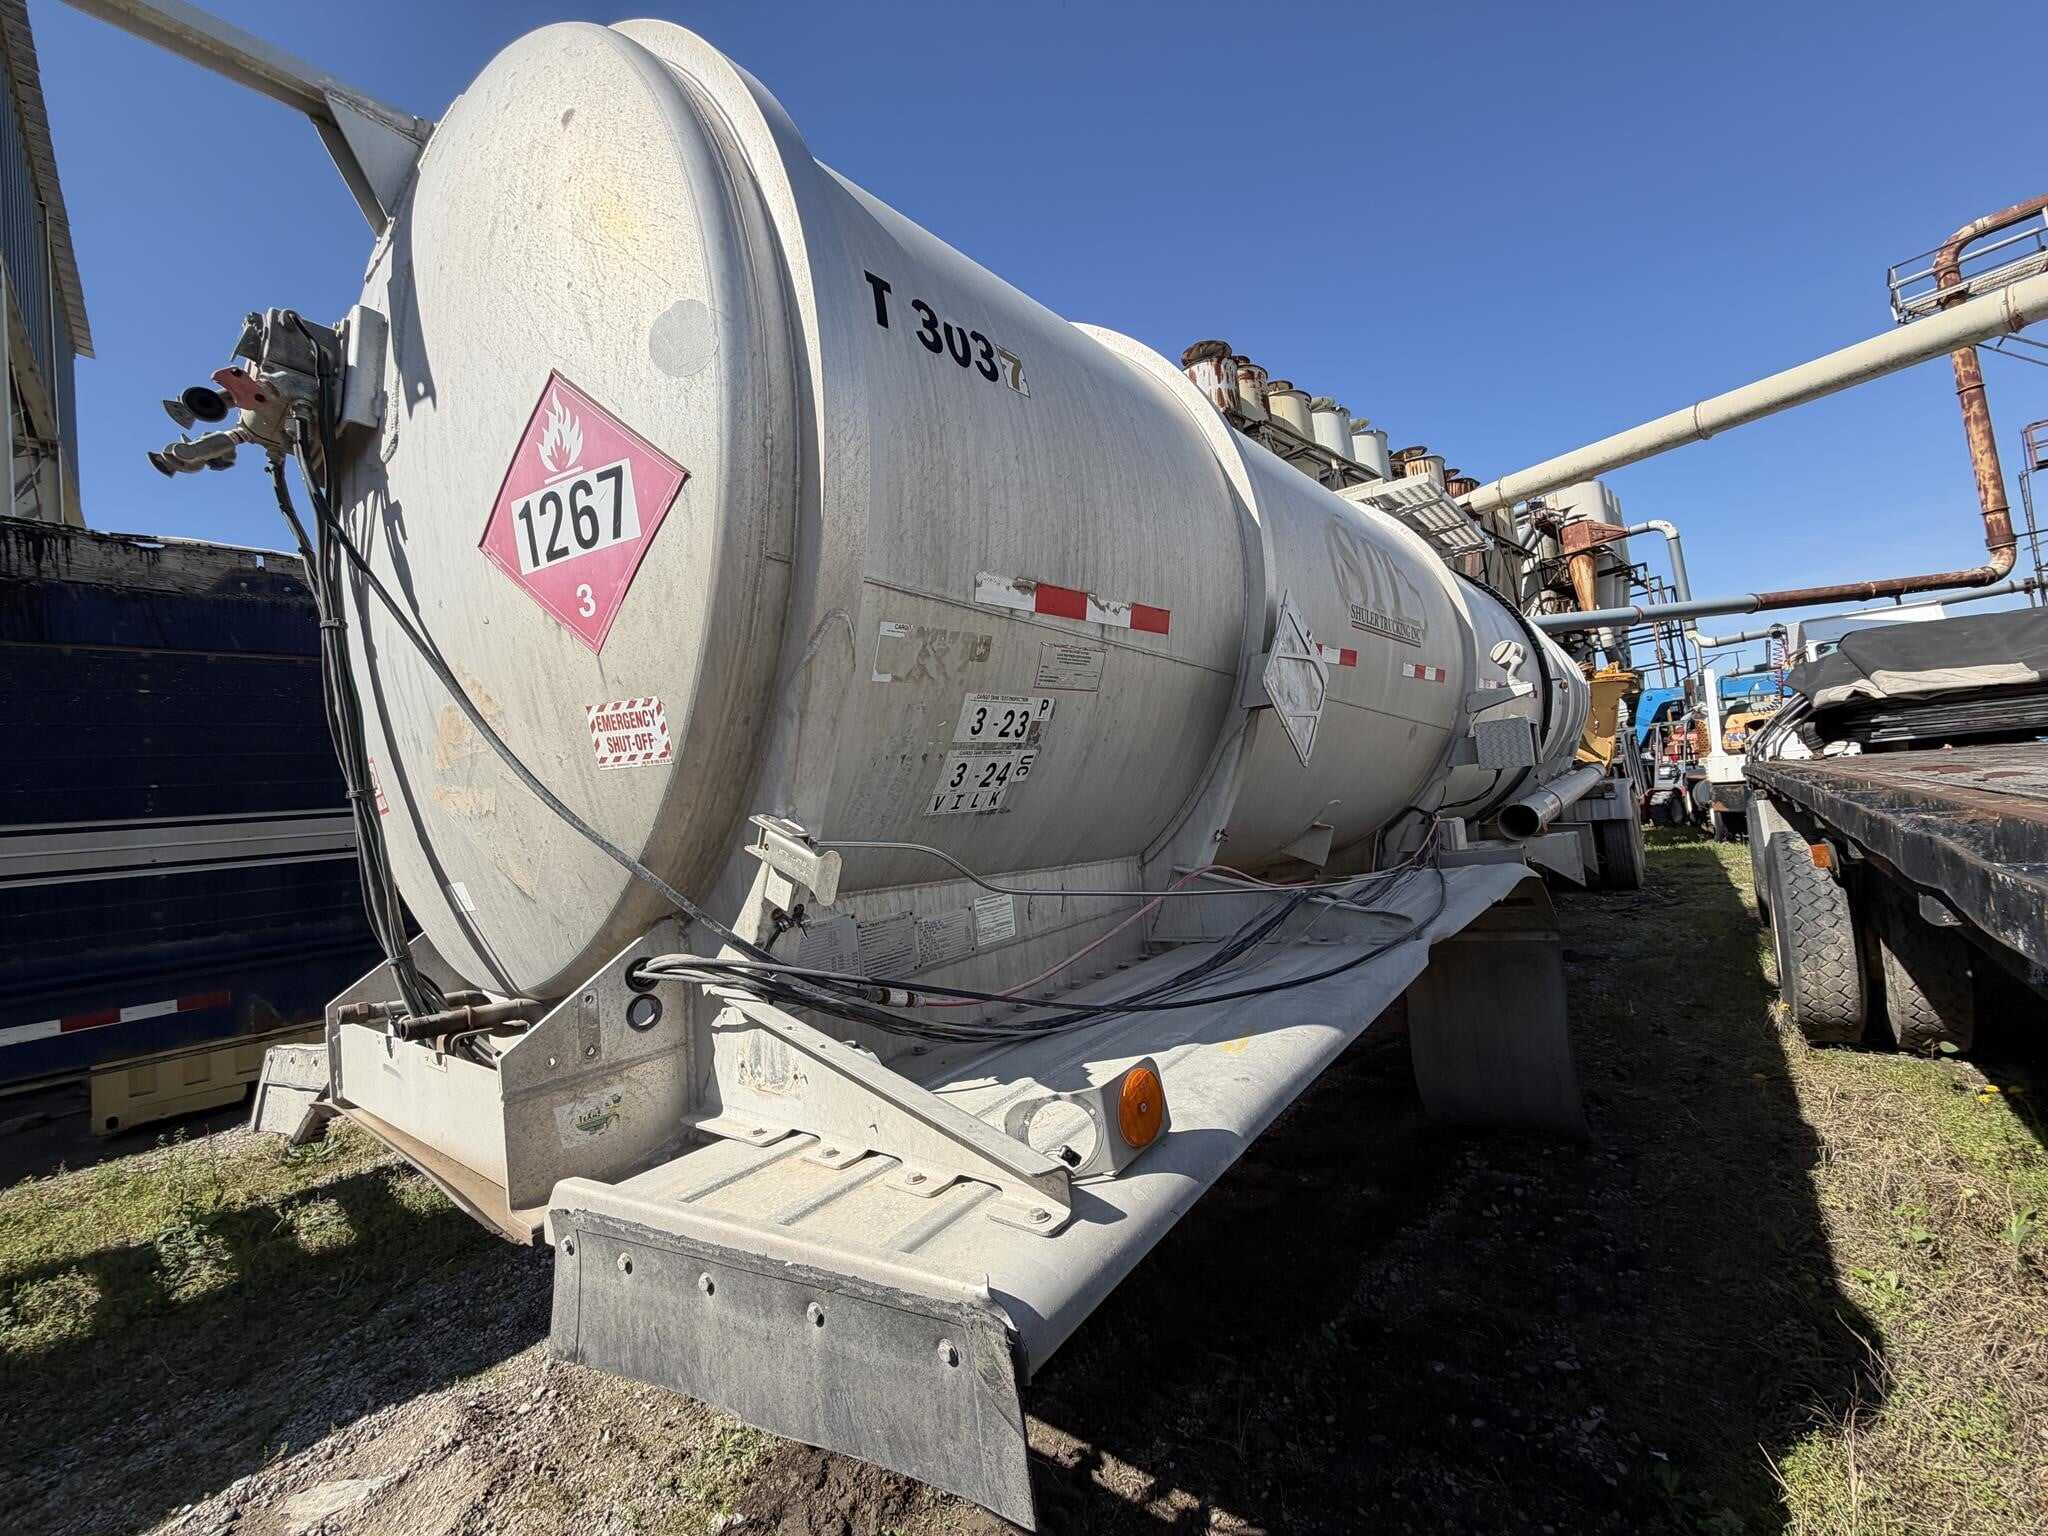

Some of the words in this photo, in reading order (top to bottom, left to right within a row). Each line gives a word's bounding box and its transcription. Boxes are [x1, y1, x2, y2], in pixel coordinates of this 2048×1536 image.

[863, 270, 892, 329] T
[518, 465, 624, 568] 1267
[576, 583, 596, 618] 3
[1351, 604, 1380, 628] SHULER
[1380, 615, 1411, 638] TRUCKING
[595, 709, 656, 733] EMERGENCY
[1039, 699, 1050, 717] P
[606, 733, 654, 754] SHUT-OFF
